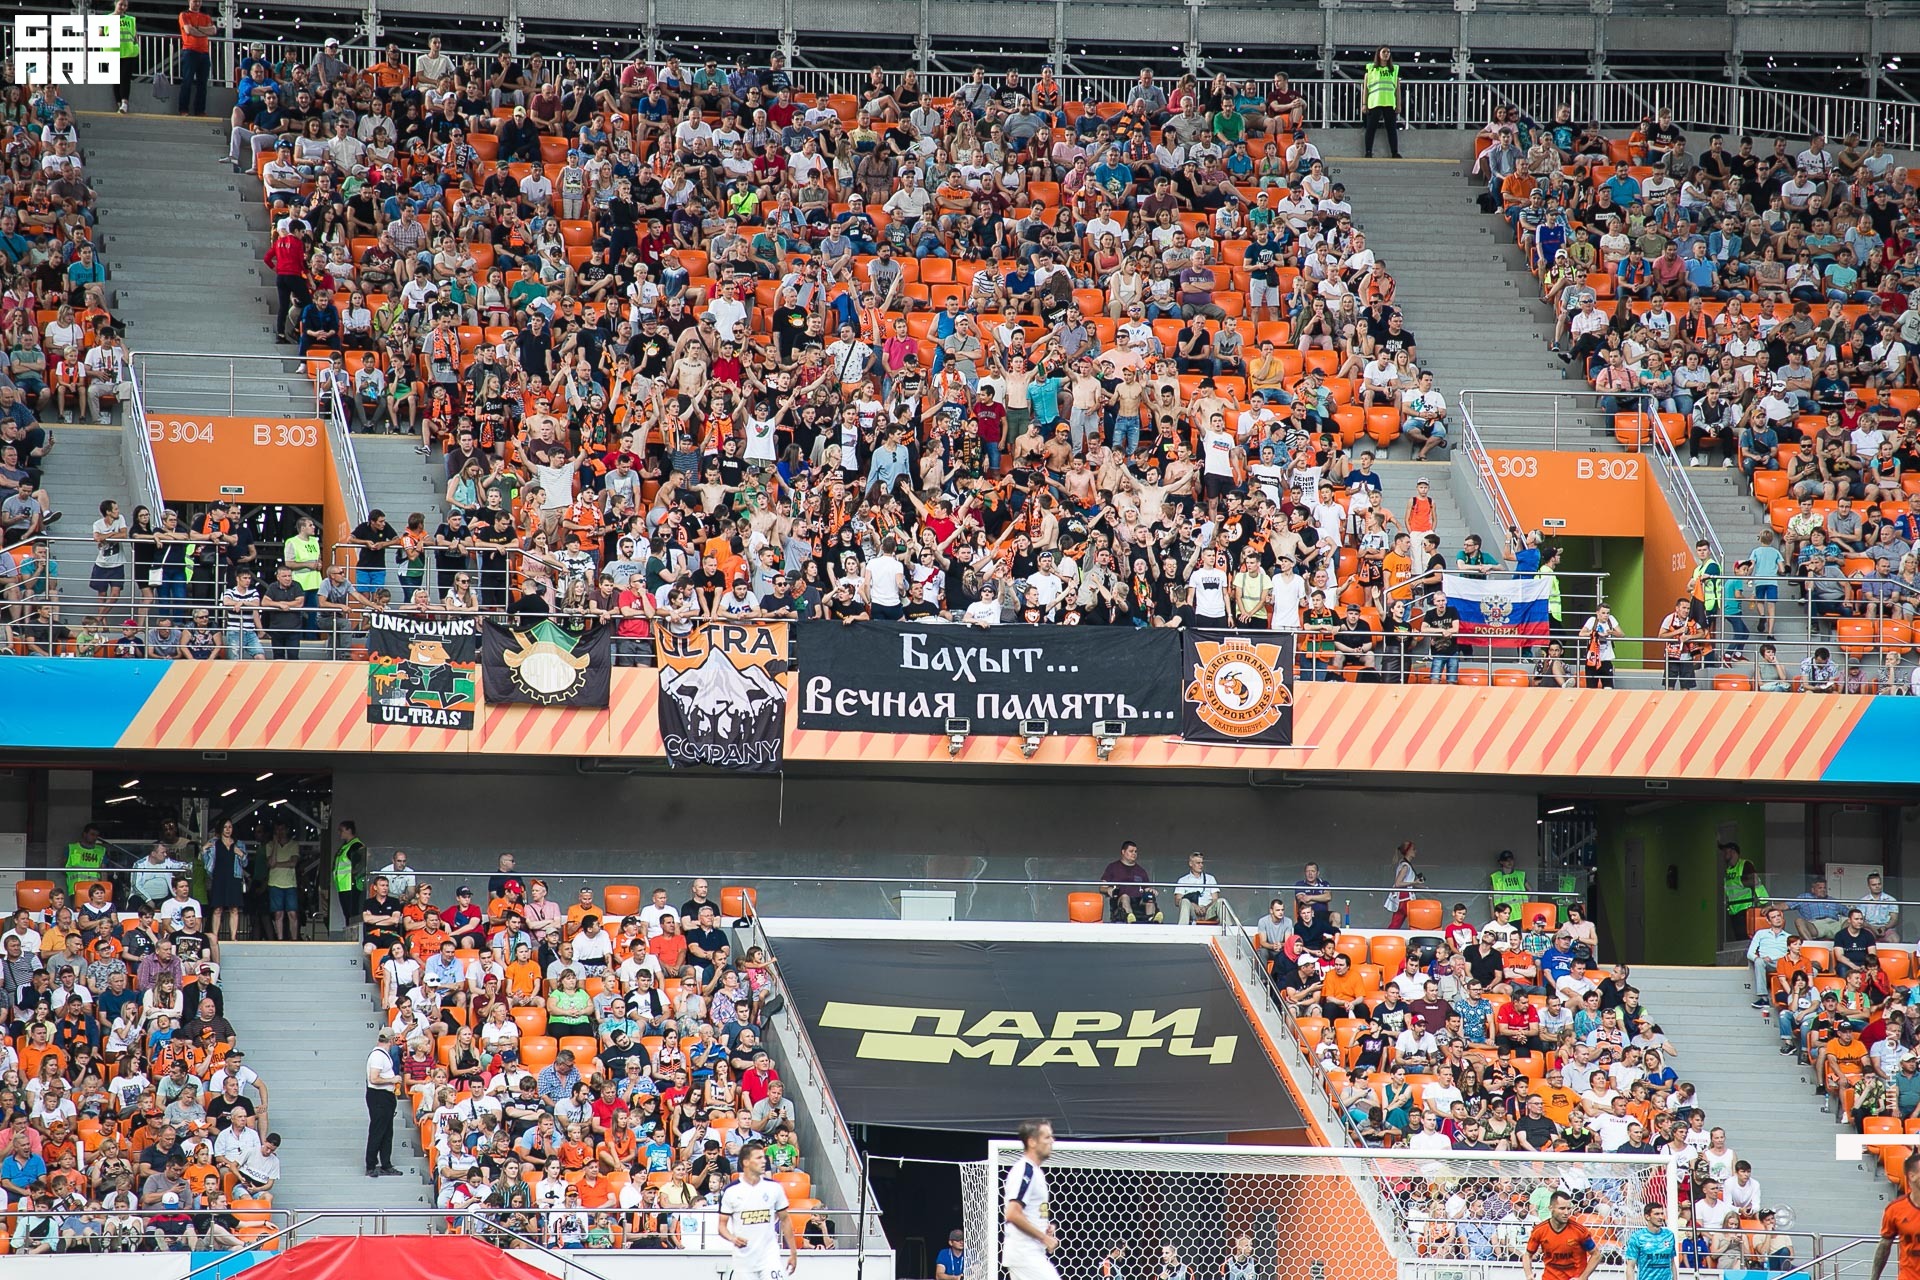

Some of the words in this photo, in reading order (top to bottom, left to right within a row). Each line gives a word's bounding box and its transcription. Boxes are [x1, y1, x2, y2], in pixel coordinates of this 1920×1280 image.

[147, 420, 165, 442] B
[168, 421, 214, 443] 304
[253, 424, 271, 446] B
[275, 425, 318, 447] 303
[1497, 456, 1538, 478] 303
[1577, 458, 1594, 479] B
[1597, 458, 1639, 481] 302
[370, 613, 475, 636] UNKNOWNS
[658, 624, 778, 658] ULTRA
[1206, 654, 1230, 684] BLACK
[1236, 653, 1272, 685] ORANGE
[802, 676, 956, 719] Вечная
[1206, 690, 1270, 720] SUPPORTERS
[381, 705, 462, 726] ULTRAS
[664, 733, 780, 765] COMPANY
[818, 1001, 1202, 1039] ПАРИ
[855, 1031, 1238, 1067] МАТЧ
